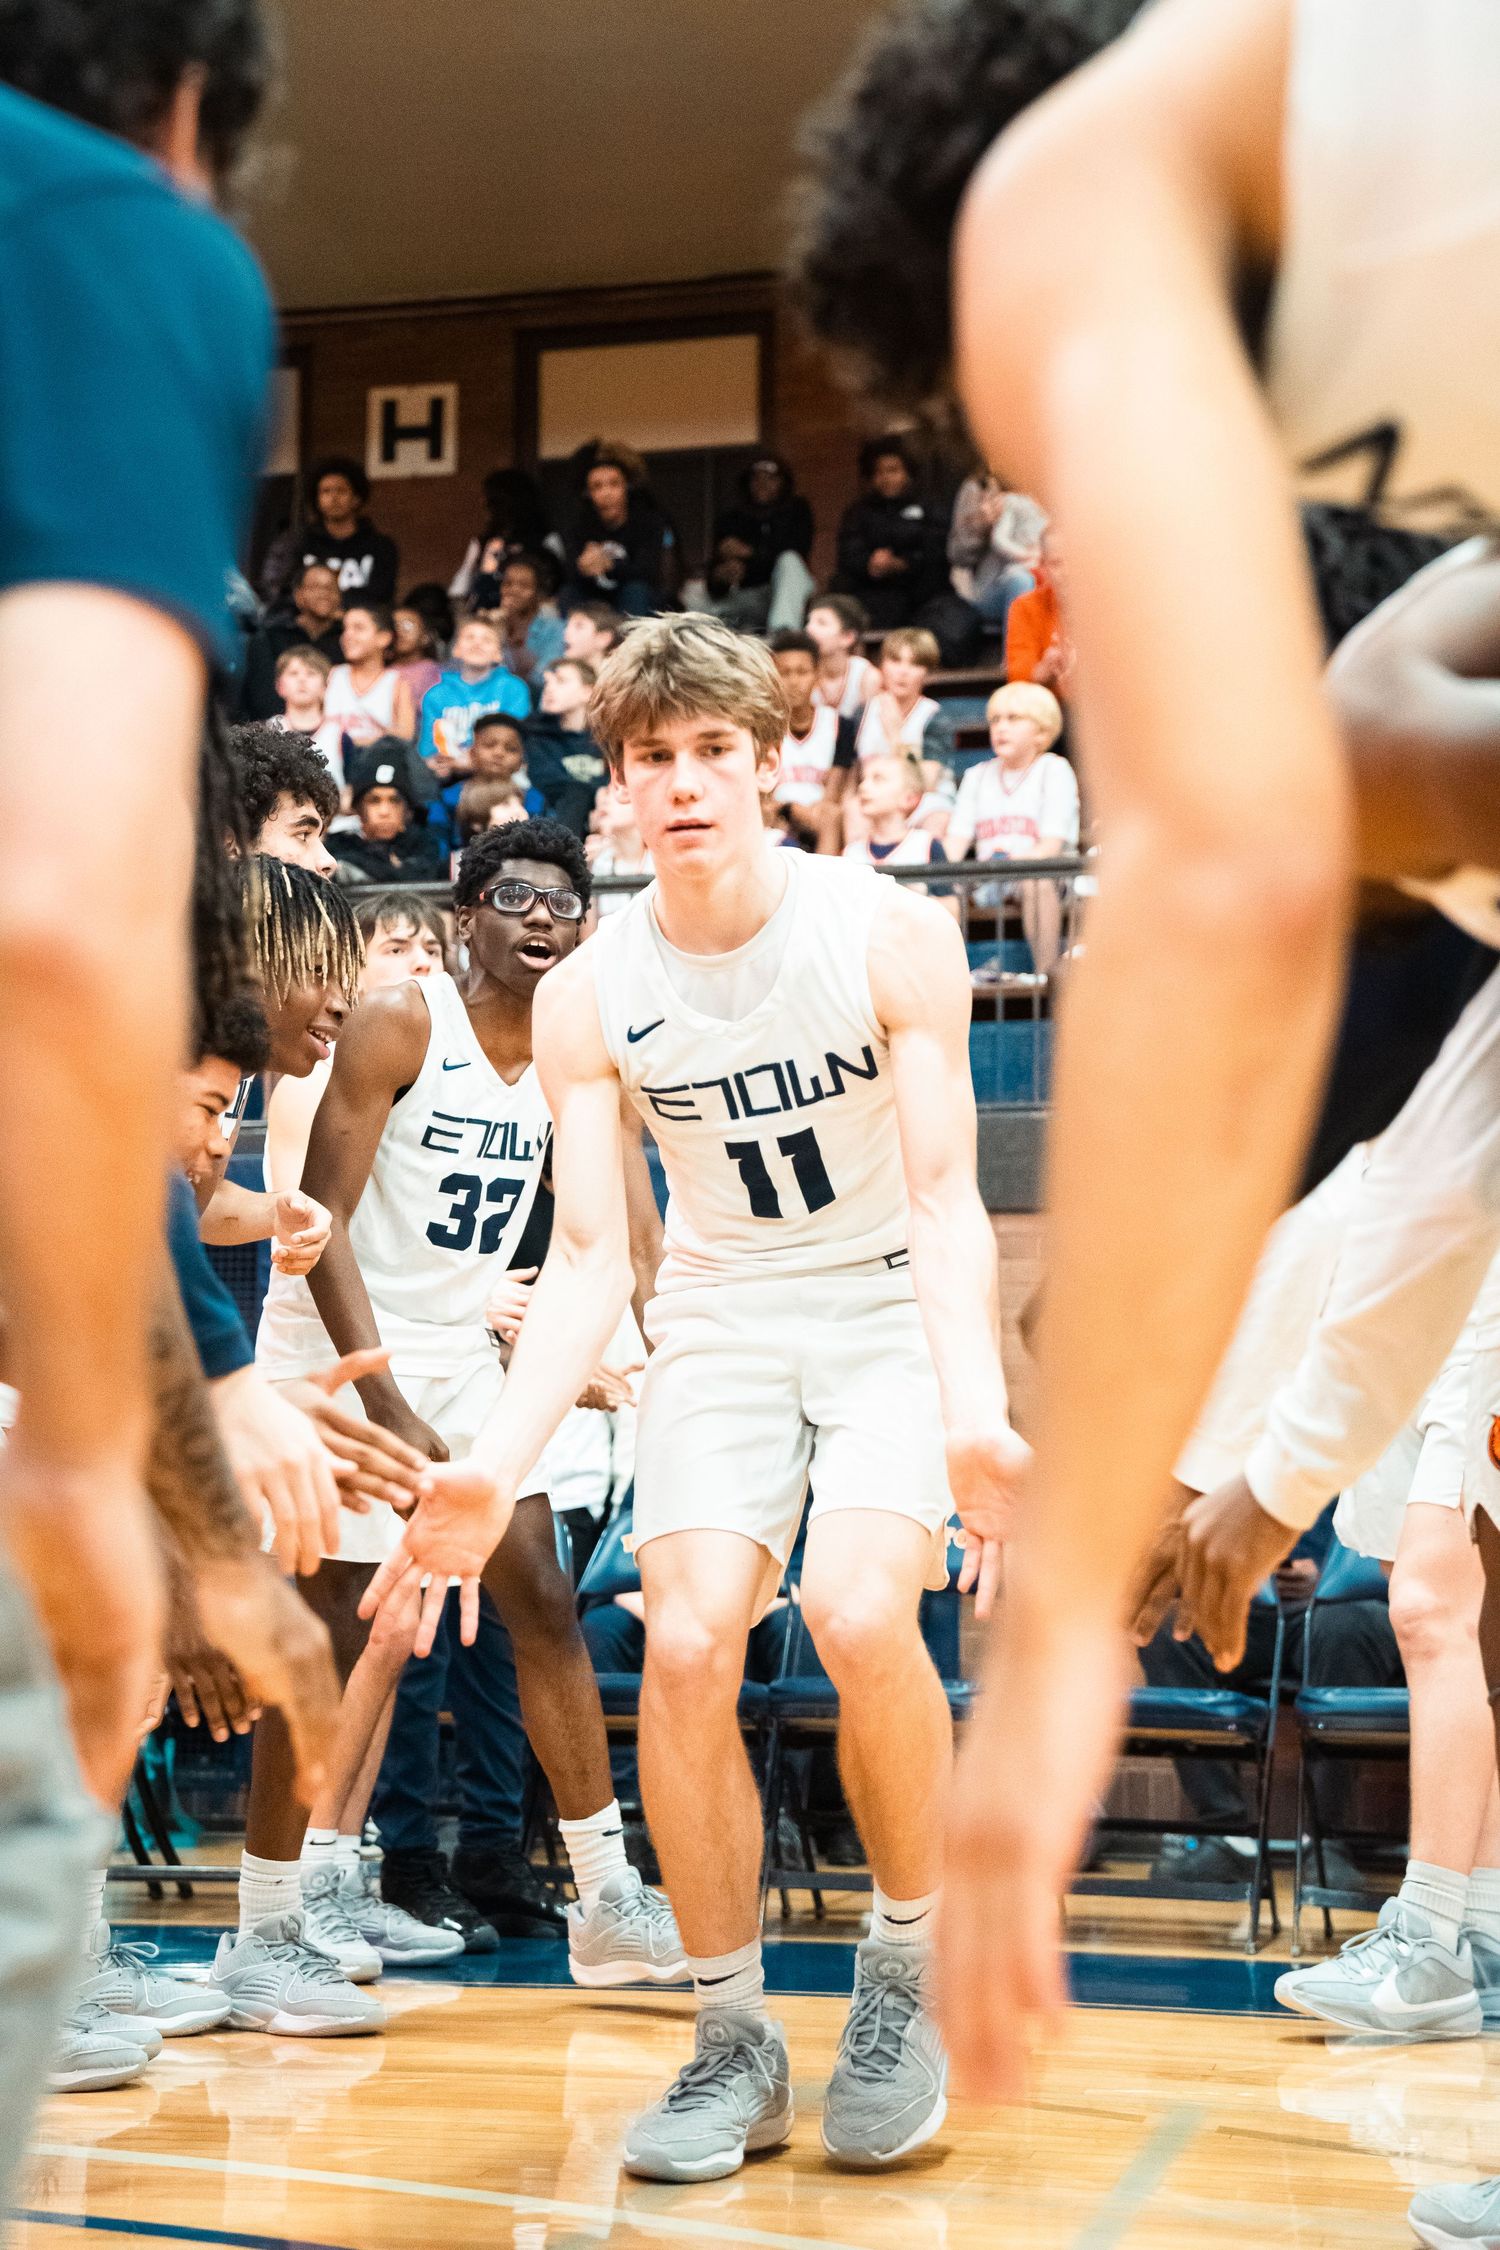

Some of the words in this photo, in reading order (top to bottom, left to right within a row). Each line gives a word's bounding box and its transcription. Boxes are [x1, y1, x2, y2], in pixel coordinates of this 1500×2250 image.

[382, 397, 444, 463] H
[640, 1044, 879, 1121] ETOWN
[724, 1126, 836, 1219] 11
[425, 1172, 526, 1255] 32
